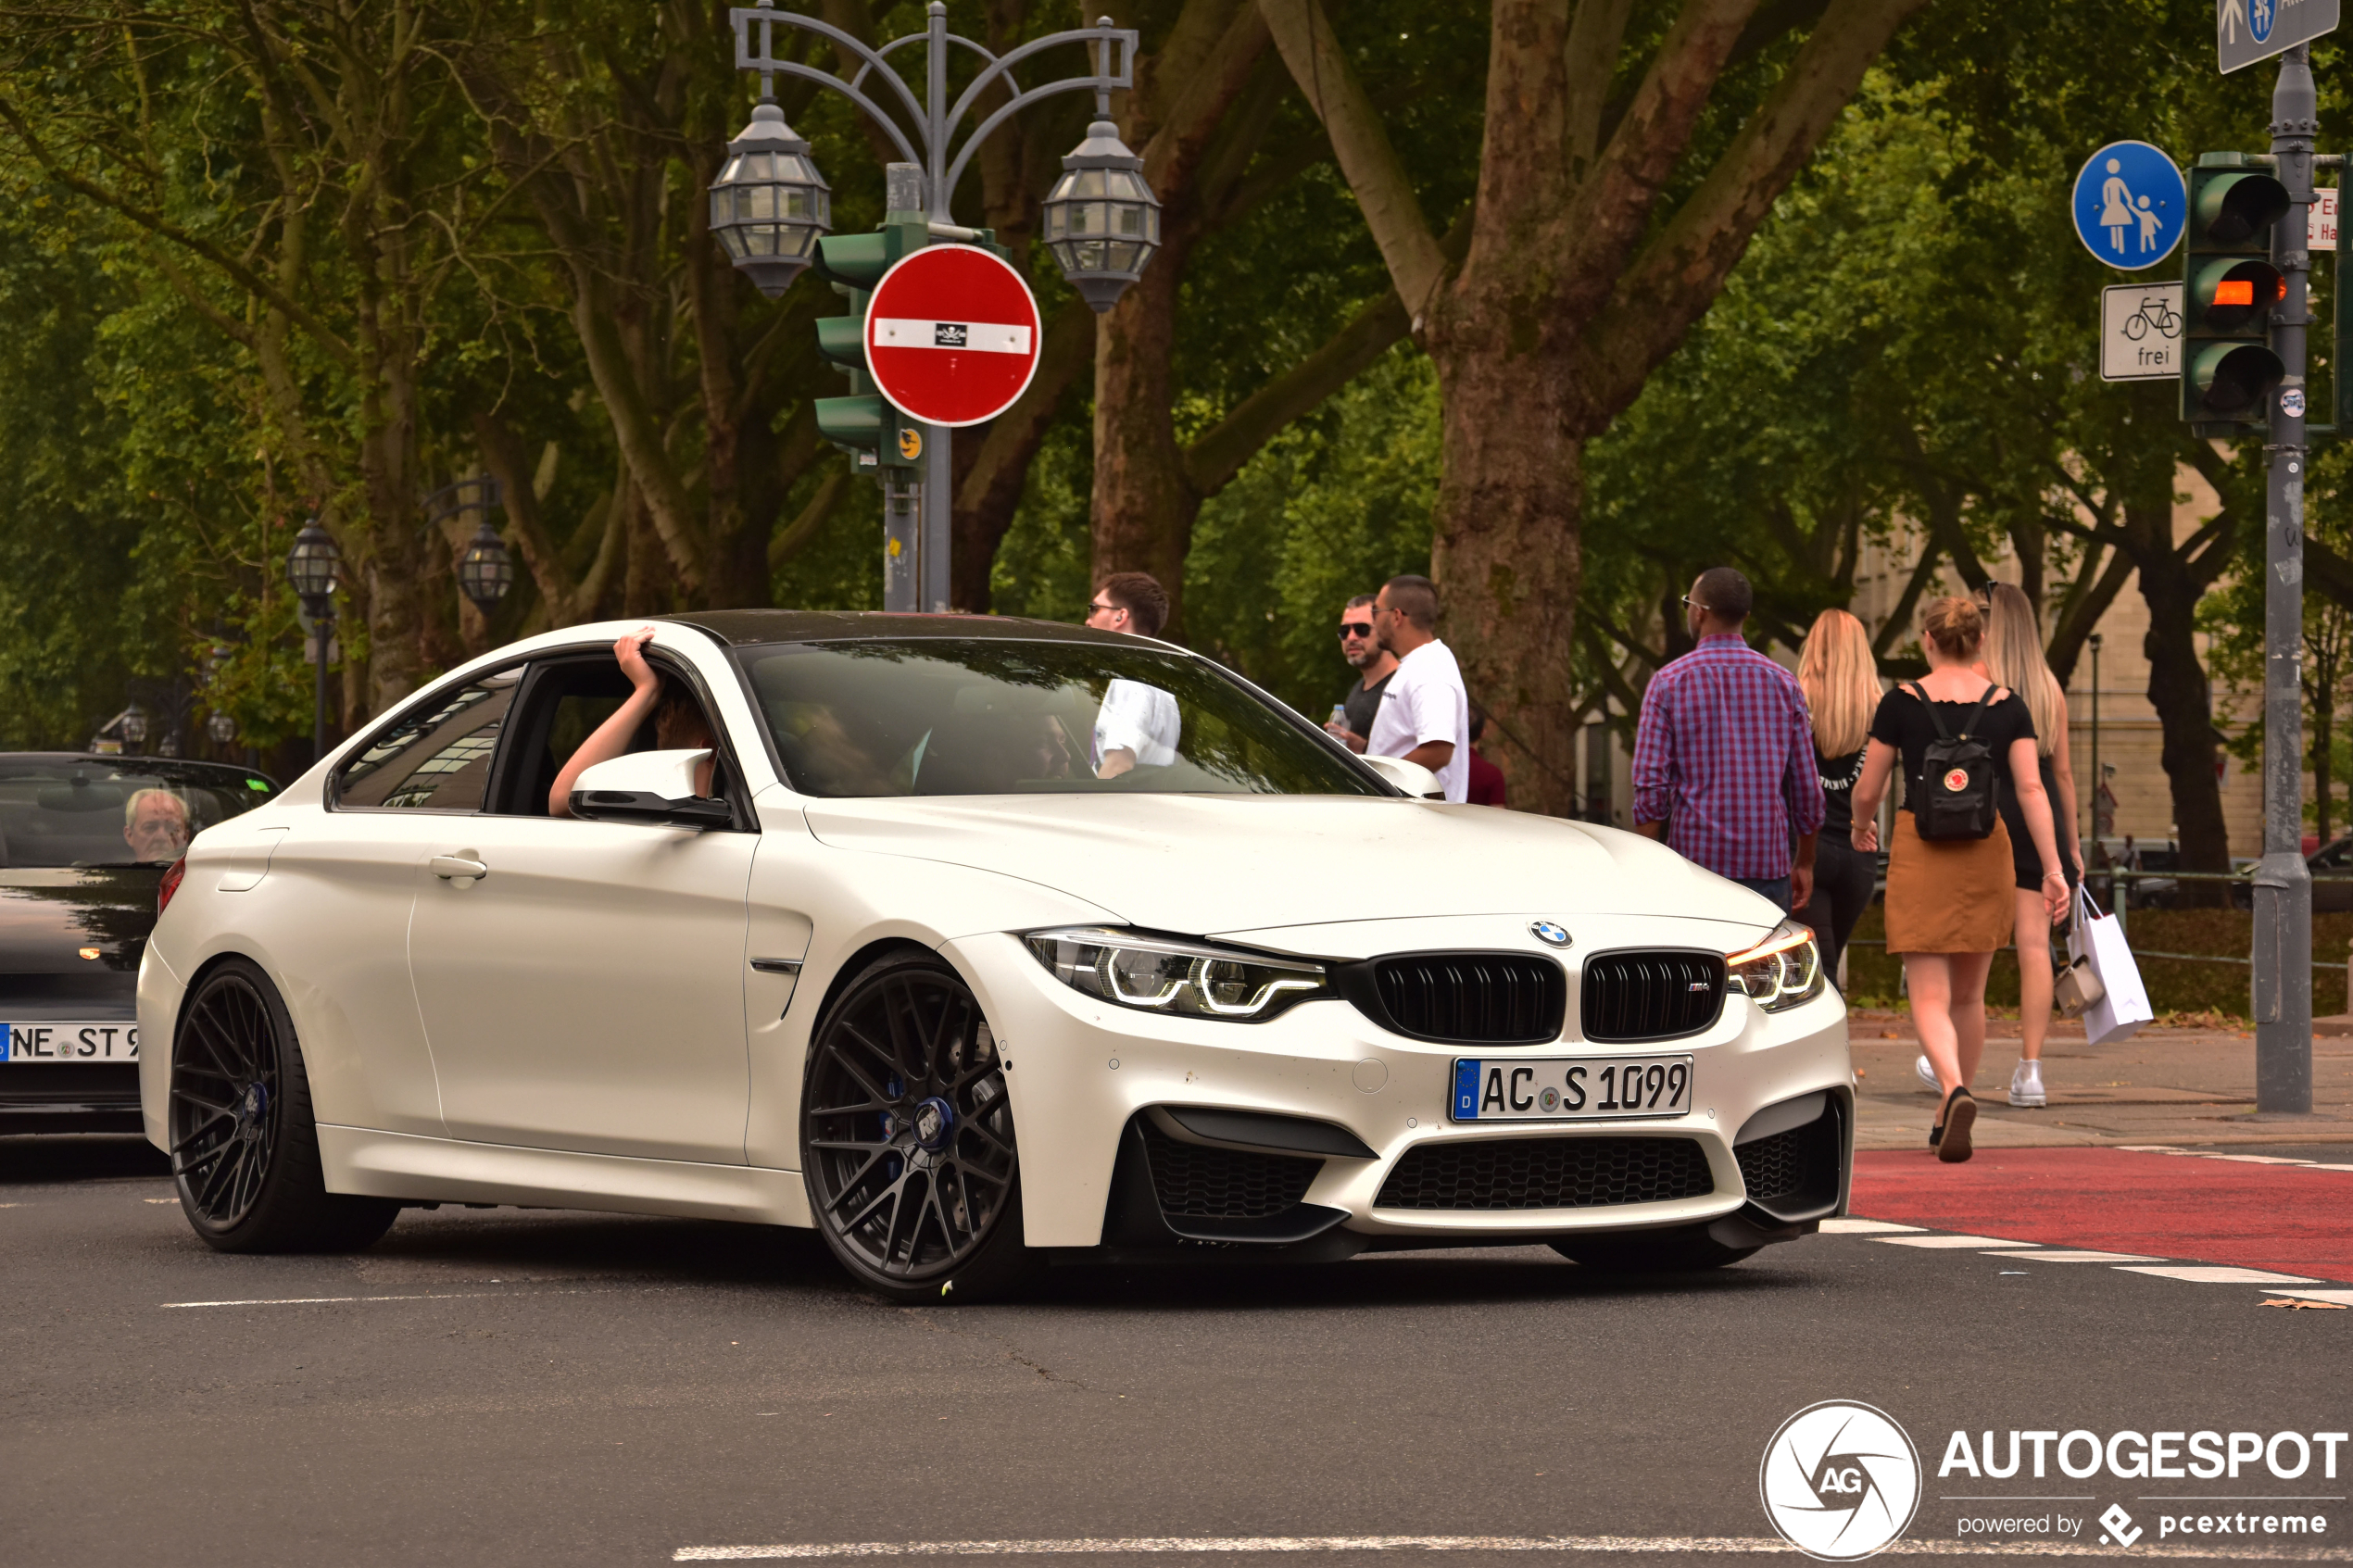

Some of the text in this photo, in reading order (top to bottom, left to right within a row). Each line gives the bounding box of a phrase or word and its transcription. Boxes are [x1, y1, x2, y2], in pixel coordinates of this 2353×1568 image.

[2138, 345, 2170, 366] frei
[12, 1028, 54, 1057] NE
[77, 1028, 119, 1057] ST
[1482, 1066, 1534, 1112] AC
[1564, 1065, 1588, 1111] S
[1597, 1063, 1688, 1110] 1099
[1462, 1096, 1471, 1109] D
